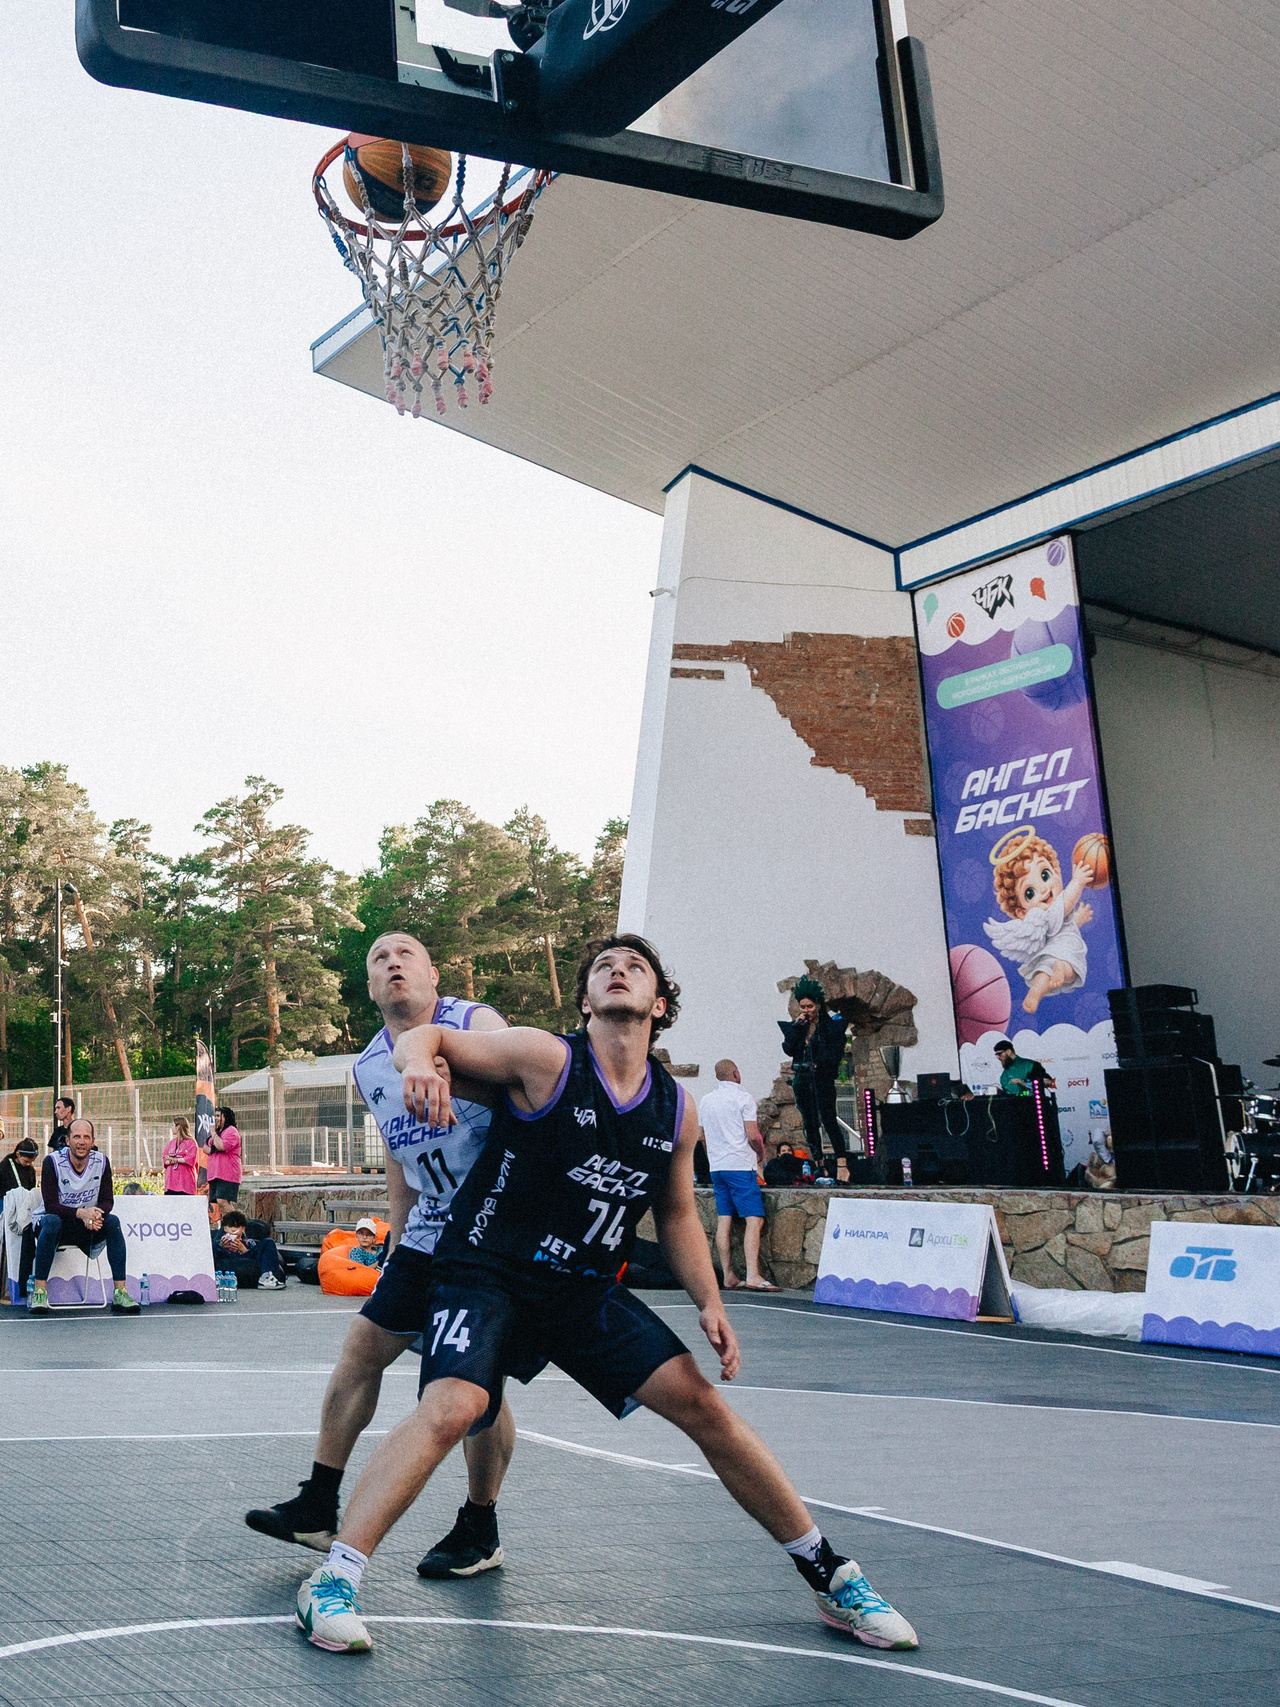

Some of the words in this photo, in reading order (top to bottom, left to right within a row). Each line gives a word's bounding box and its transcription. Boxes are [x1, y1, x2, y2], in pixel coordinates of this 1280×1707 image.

[417, 1148, 458, 1194] 11
[127, 1222, 192, 1241] xpage
[582, 1199, 626, 1251] 74
[844, 1229, 889, 1240] НИАГАРА
[540, 1234, 576, 1260] JET
[1169, 1246, 1237, 1282] ОТВ
[431, 1309, 470, 1356] 74
